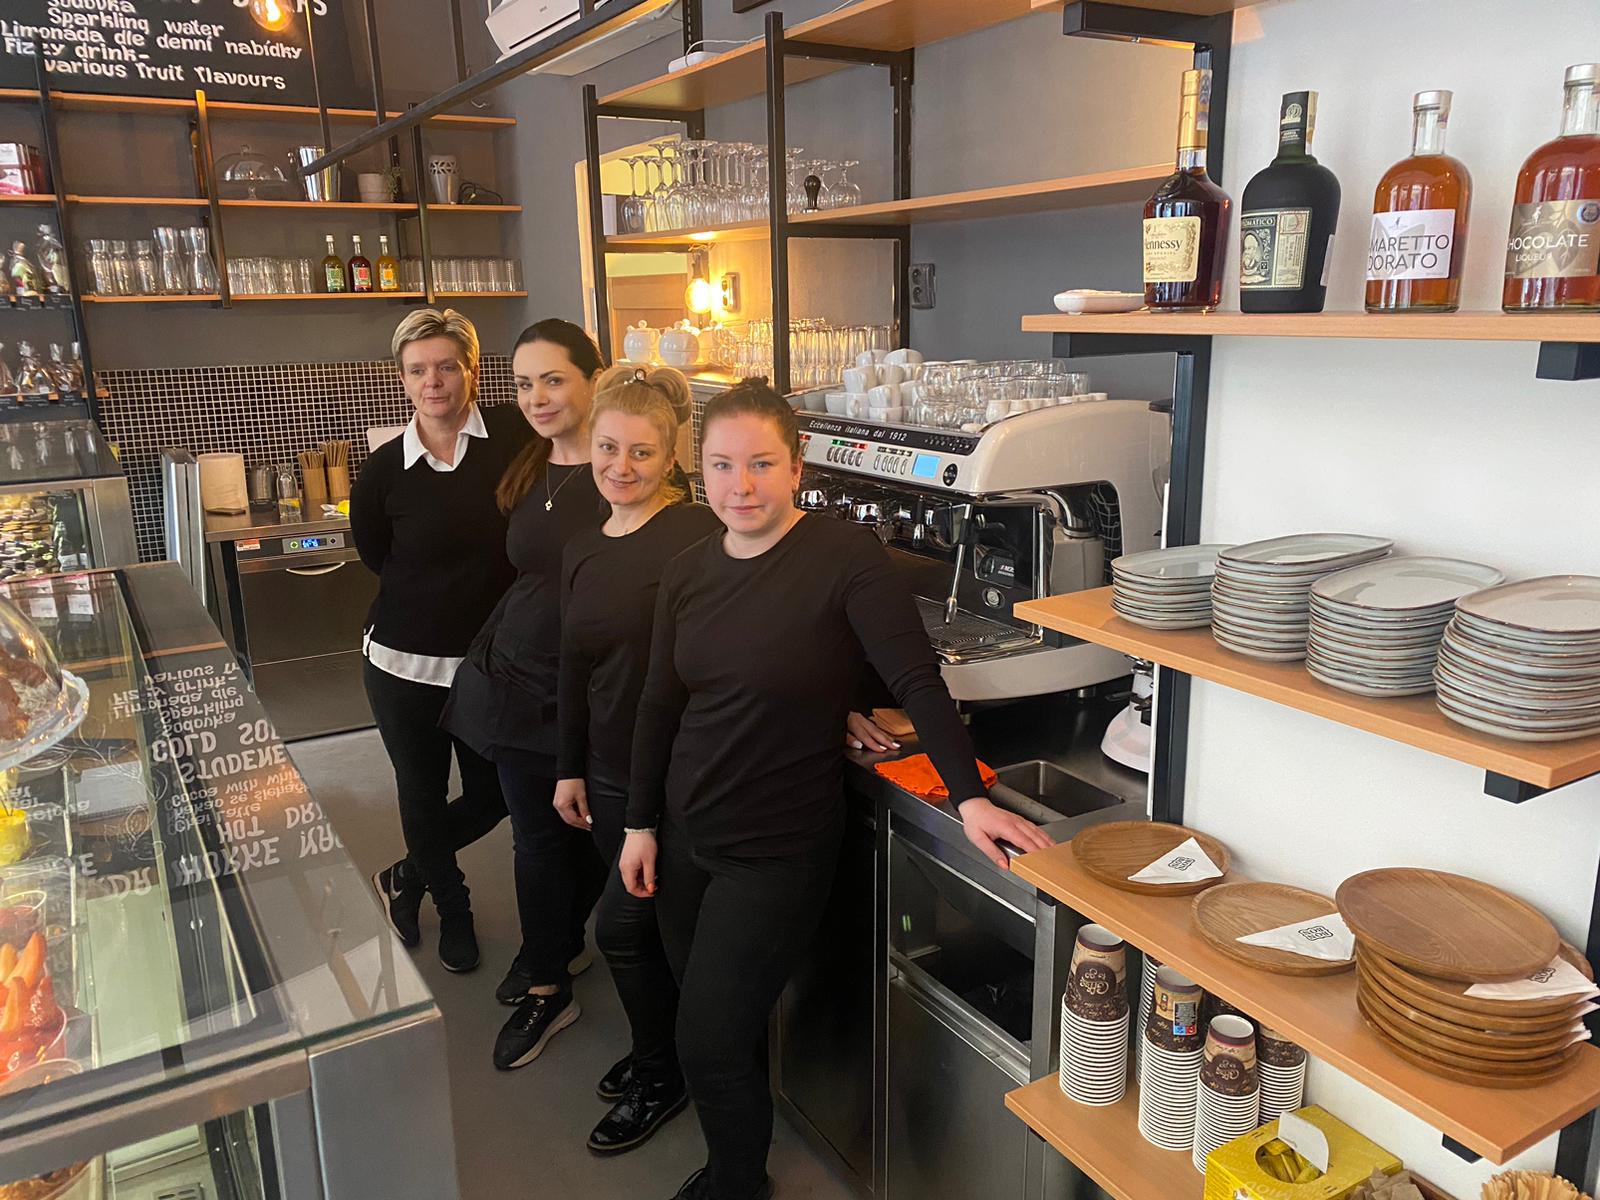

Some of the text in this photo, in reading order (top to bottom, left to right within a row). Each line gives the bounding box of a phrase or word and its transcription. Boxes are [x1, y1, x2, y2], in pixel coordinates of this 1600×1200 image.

[47, 7, 225, 38] Sparkling water
[113, 30, 145, 46] dle
[156, 33, 213, 52] denní
[224, 40, 303, 59] nabídky
[45, 59, 286, 90] various fruit flavours
[1145, 239, 1183, 252] ennessy
[1369, 234, 1450, 252] MARETTO
[1507, 234, 1590, 250] HOCOLATE
[889, 431, 908, 441] 1912
